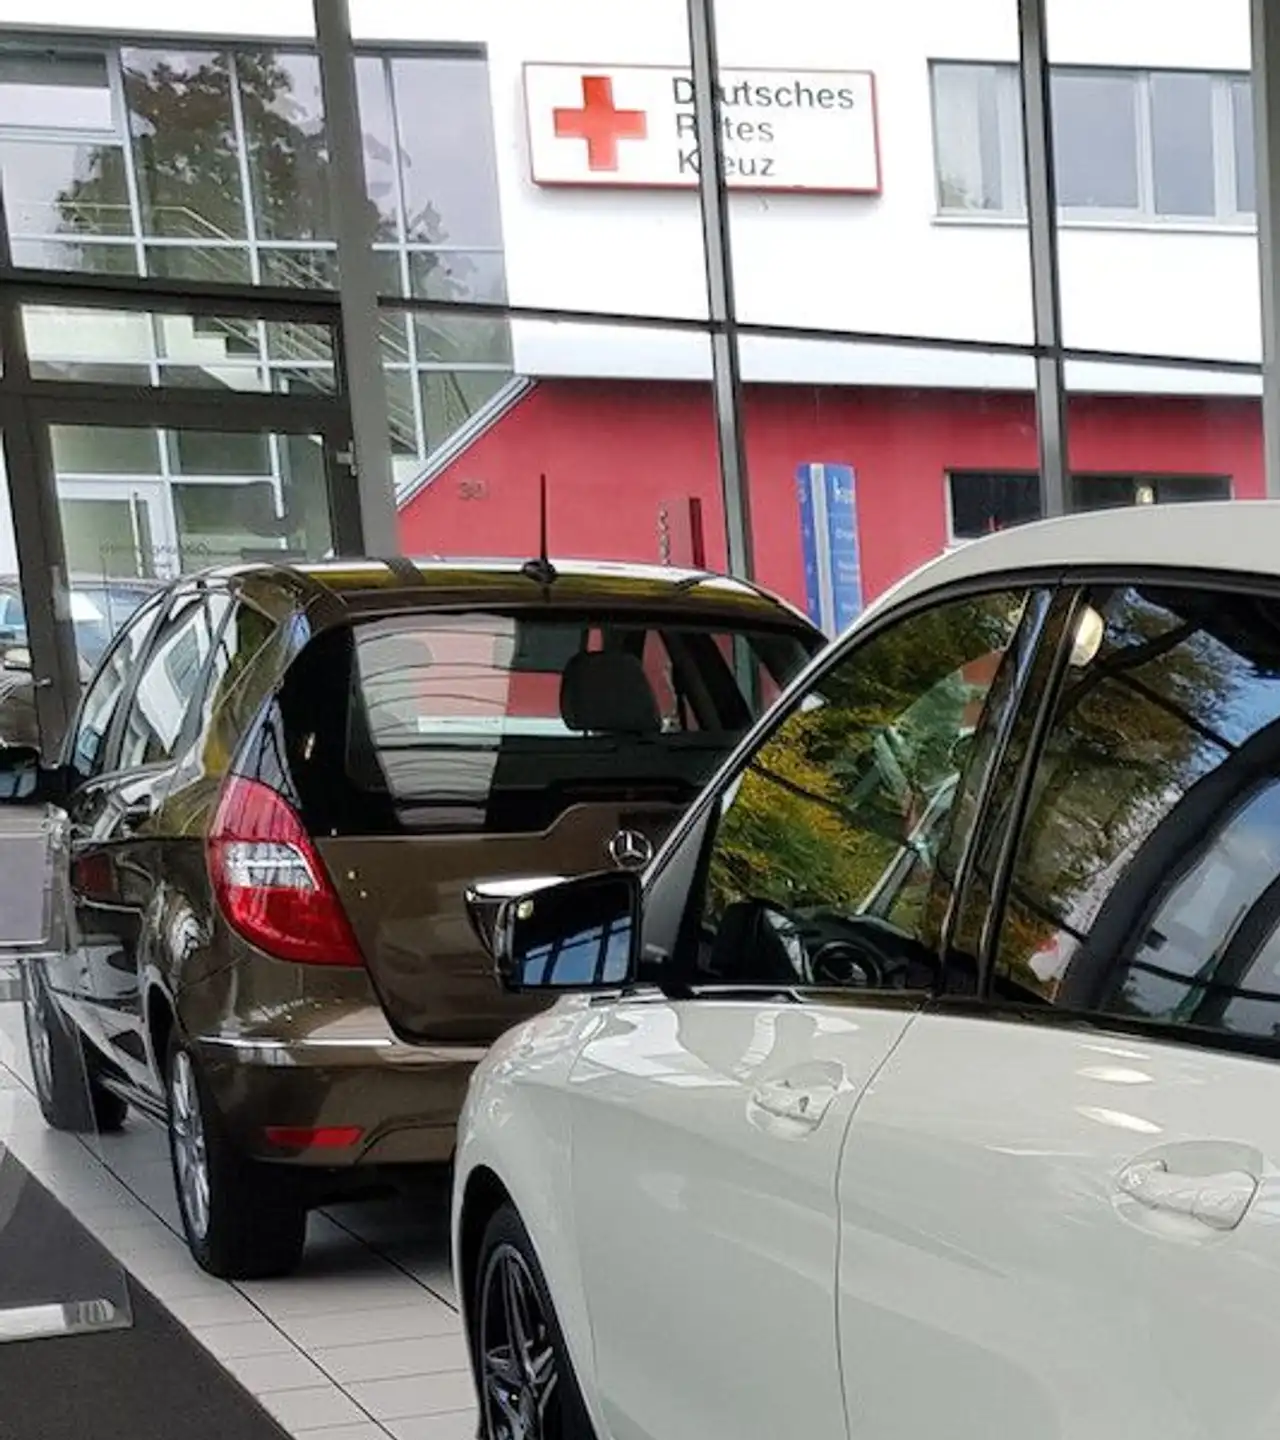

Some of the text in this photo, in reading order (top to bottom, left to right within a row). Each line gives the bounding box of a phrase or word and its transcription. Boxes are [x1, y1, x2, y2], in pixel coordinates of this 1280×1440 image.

[672, 77, 854, 110] Dutsches
[676, 113, 775, 142] Rtes
[678, 148, 776, 176] Keuz
